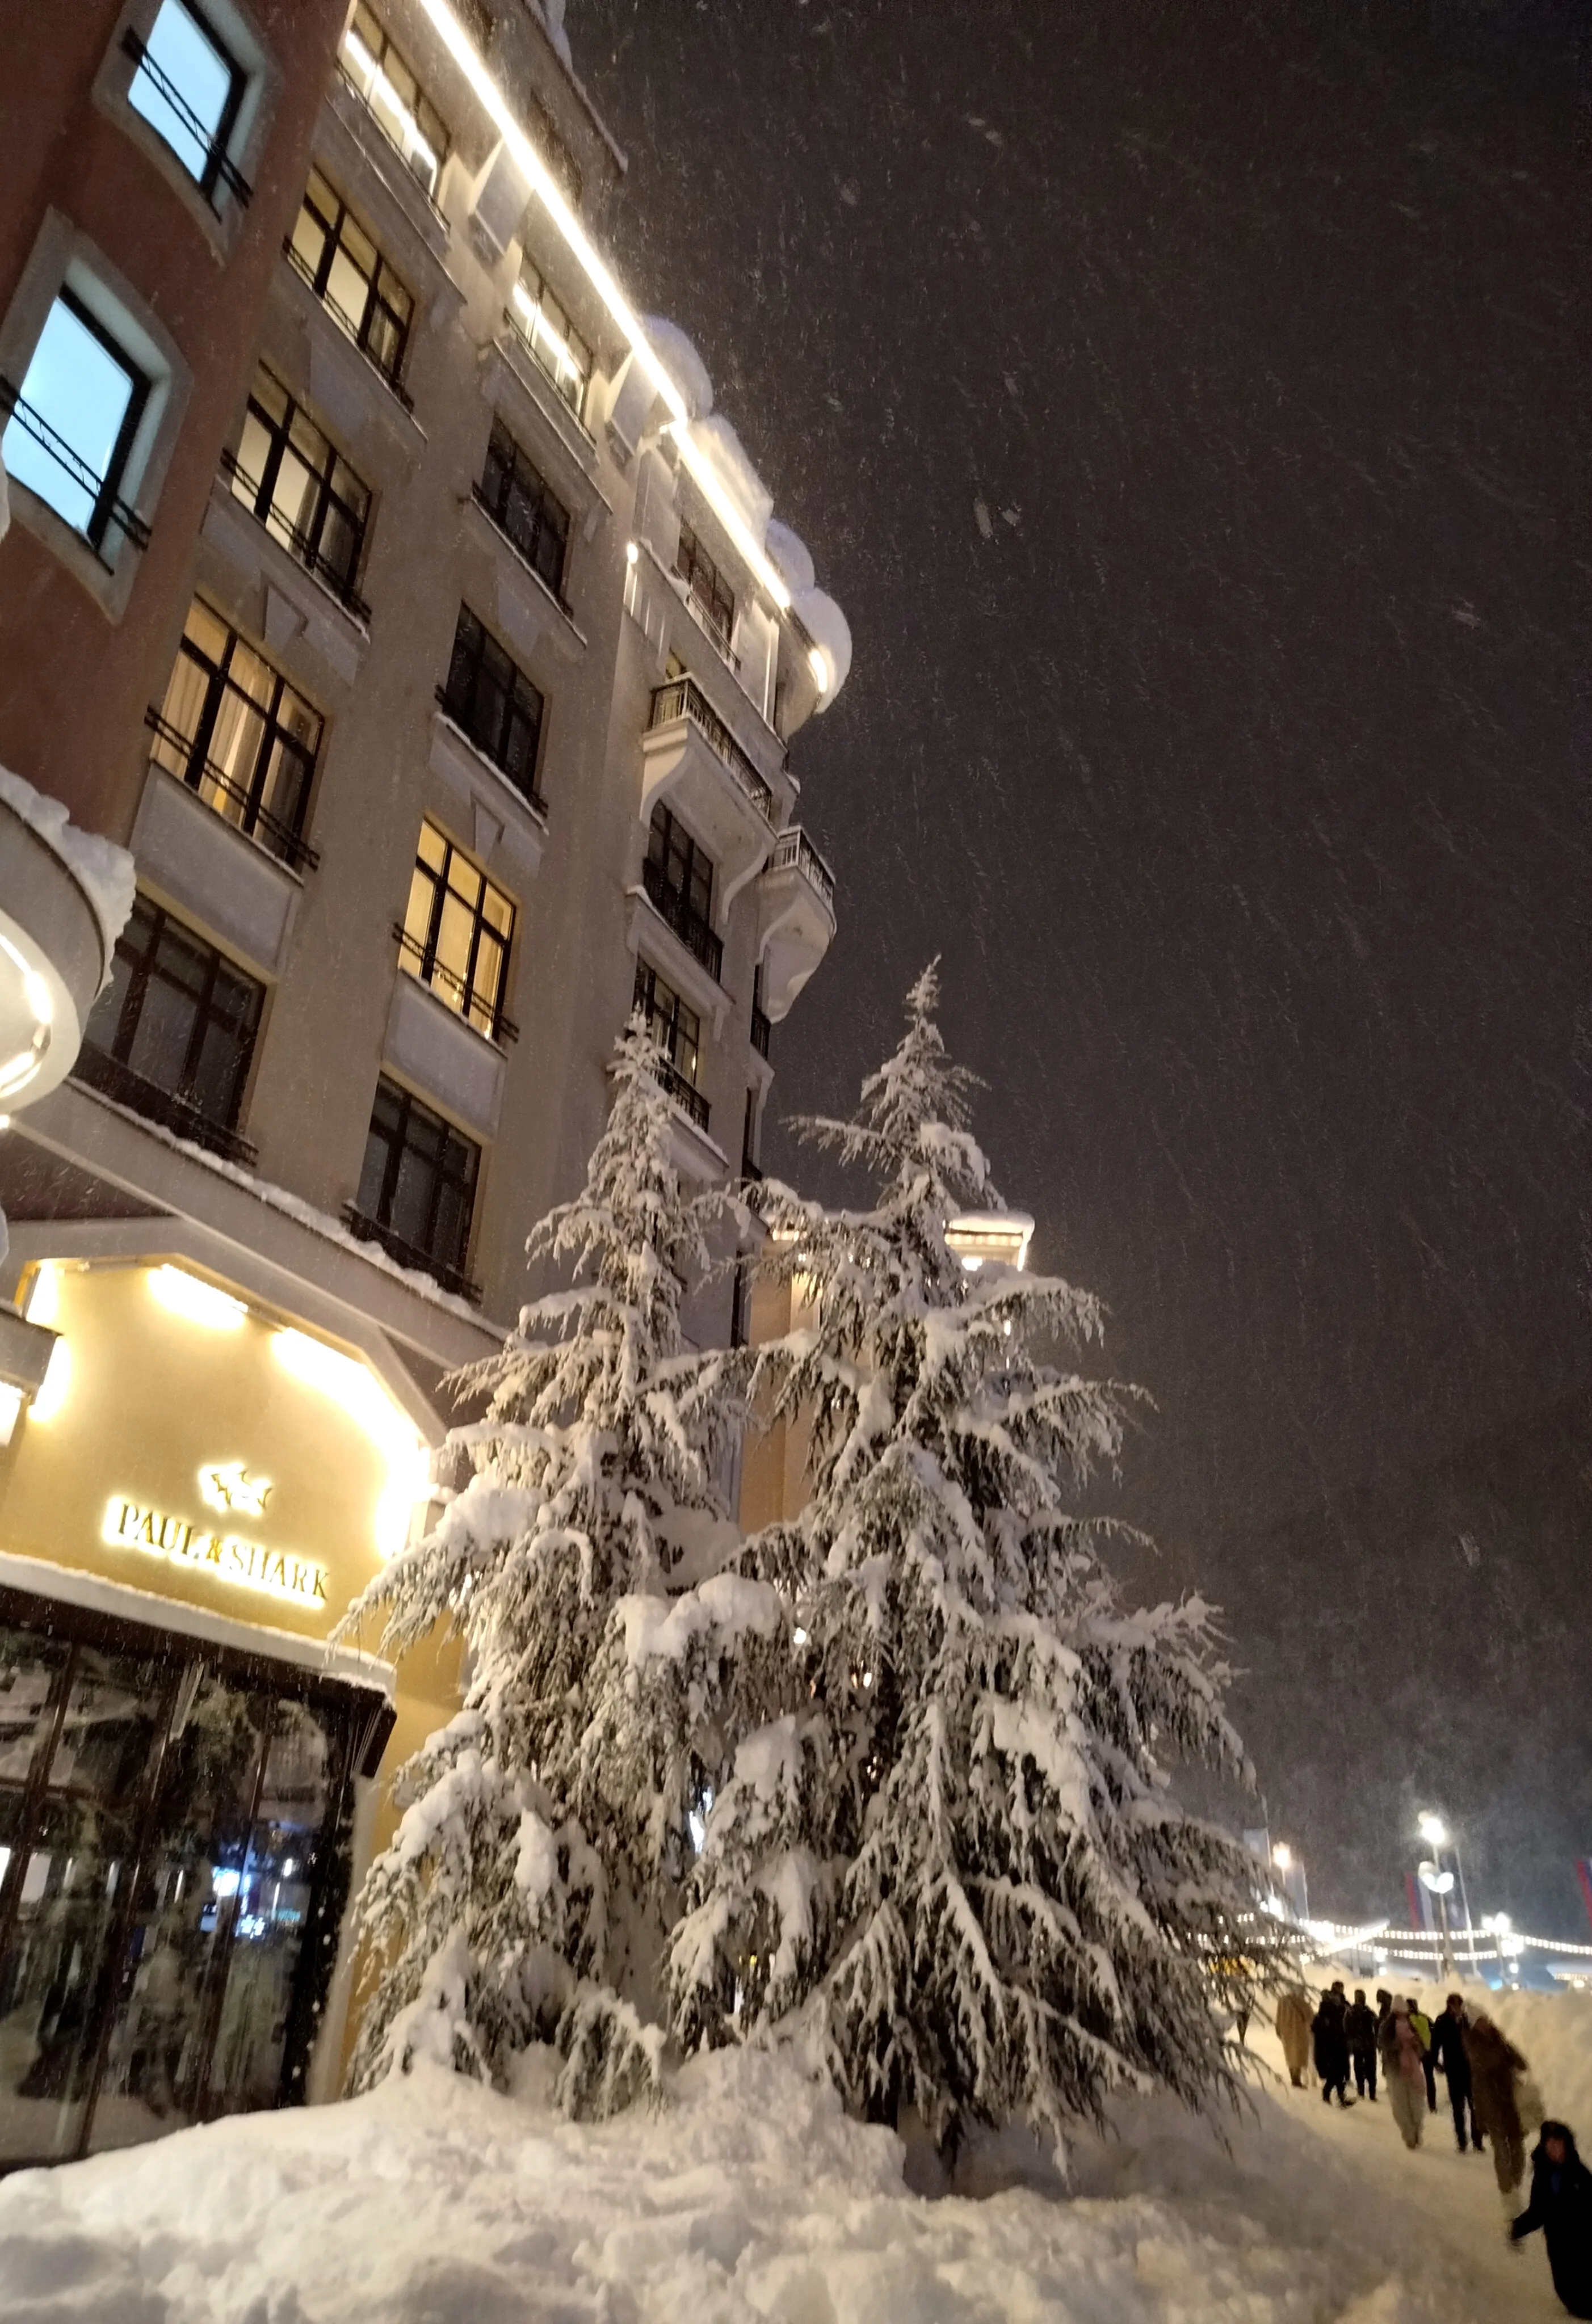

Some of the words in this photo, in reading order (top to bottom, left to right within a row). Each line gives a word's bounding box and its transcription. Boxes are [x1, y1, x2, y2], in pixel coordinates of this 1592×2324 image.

[118, 1504, 199, 1560] PAUL
[205, 1538, 222, 1563] &
[229, 1544, 329, 1600] SHARK
